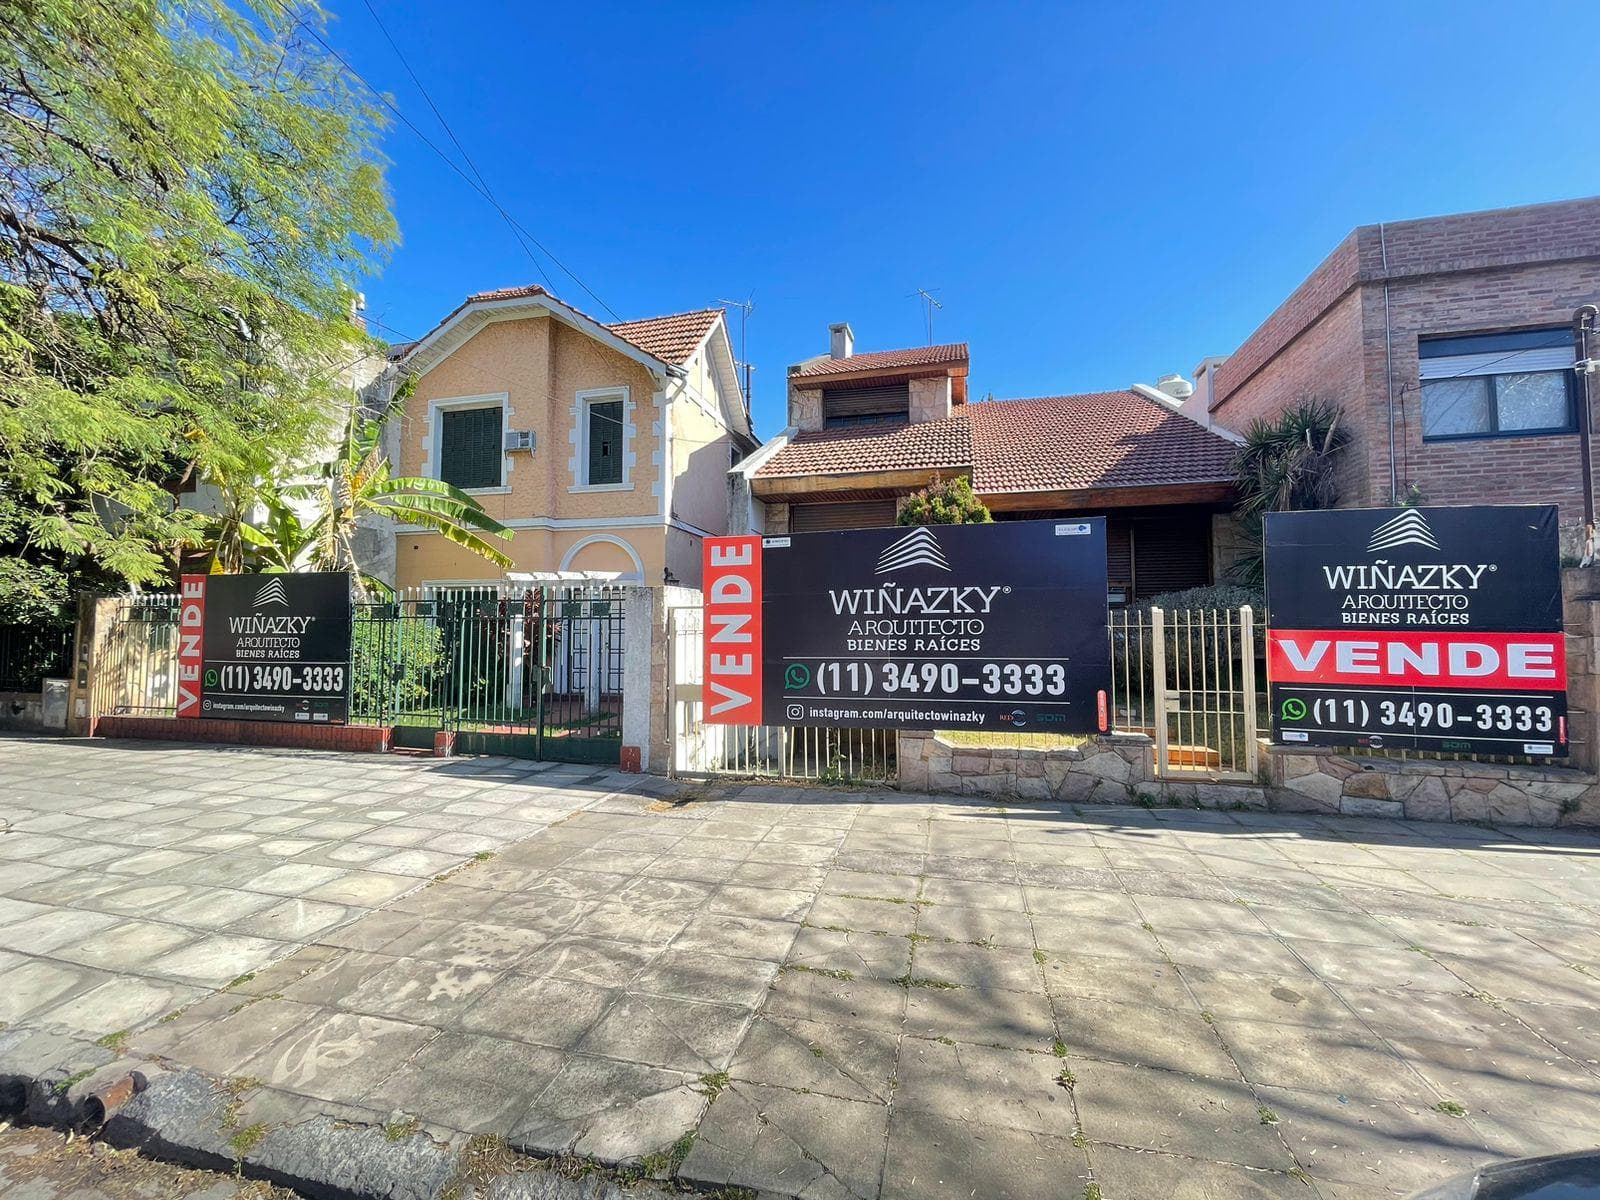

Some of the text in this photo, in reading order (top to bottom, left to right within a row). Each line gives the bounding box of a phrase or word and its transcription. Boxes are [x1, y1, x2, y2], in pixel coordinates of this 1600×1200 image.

[1341, 594, 1469, 610] ARQUITECTO
[847, 618, 985, 636] ARQUITECTO
[1341, 610, 1470, 625] BIENES RAÍCES
[710, 543, 753, 717] VENDE
[178, 581, 205, 712] VENDE
[236, 637, 301, 648] ARQUITECTO
[847, 636, 980, 651] BIENES RAÍCES
[235, 649, 301, 659] BIENES RAÍCES
[1278, 639, 1556, 679] VENDE
[220, 665, 344, 692] (11) 3490-3333
[816, 662, 1066, 696] (11) 3490-3333
[809, 706, 986, 725] instagram.com/arquitectowinazky
[1313, 698, 1370, 728] (11)
[1380, 700, 1552, 732] 3490-3333
